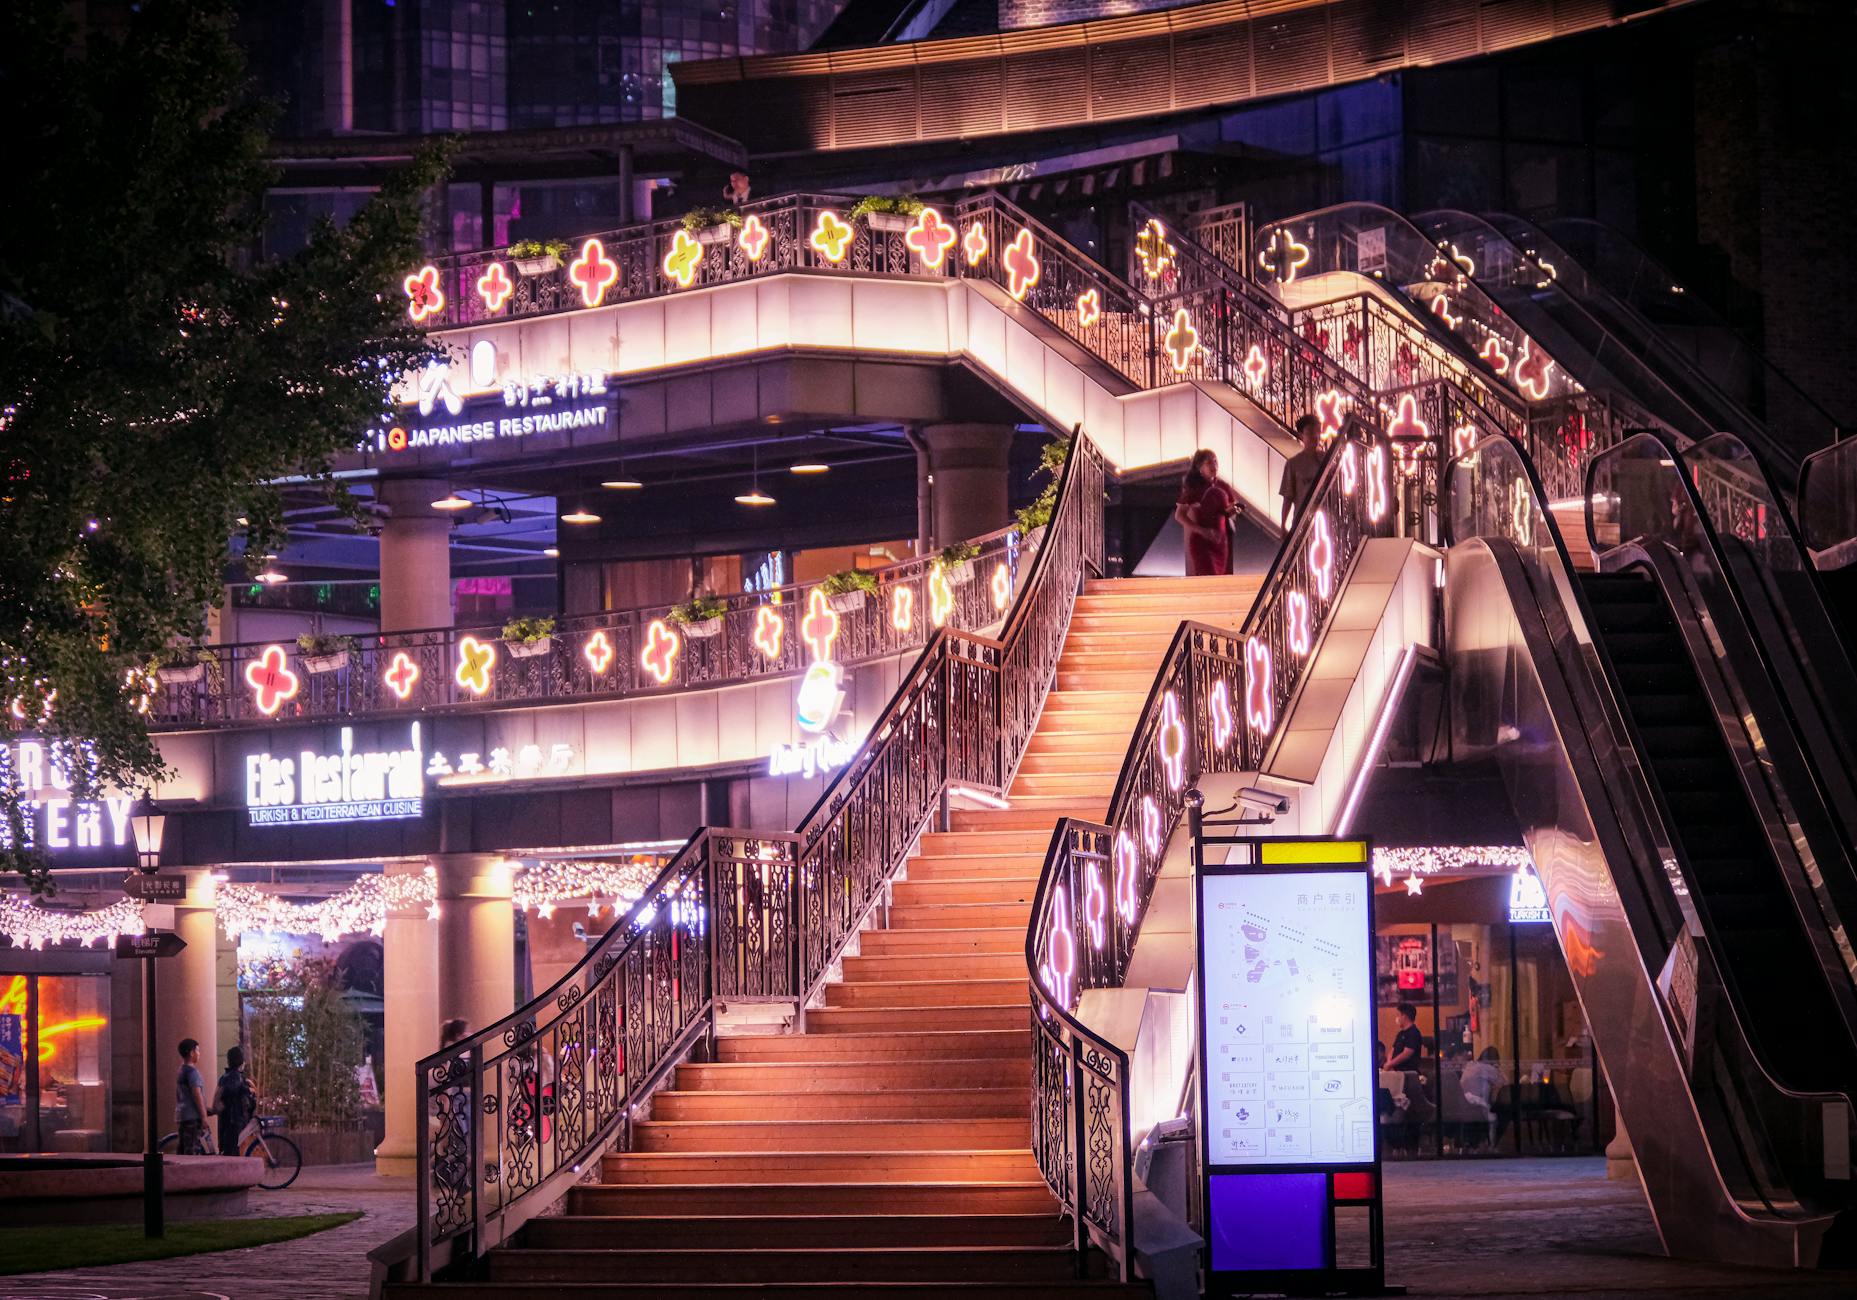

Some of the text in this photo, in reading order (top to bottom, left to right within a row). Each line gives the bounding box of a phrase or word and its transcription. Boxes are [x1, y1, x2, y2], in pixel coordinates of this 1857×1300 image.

[408, 421, 495, 448] JAPANESE
[499, 406, 607, 438] RESTAURANT
[250, 801, 421, 823] TURKISH & MEDITERRANEAN CUISINE
[1510, 910, 1539, 920] TURKISH
